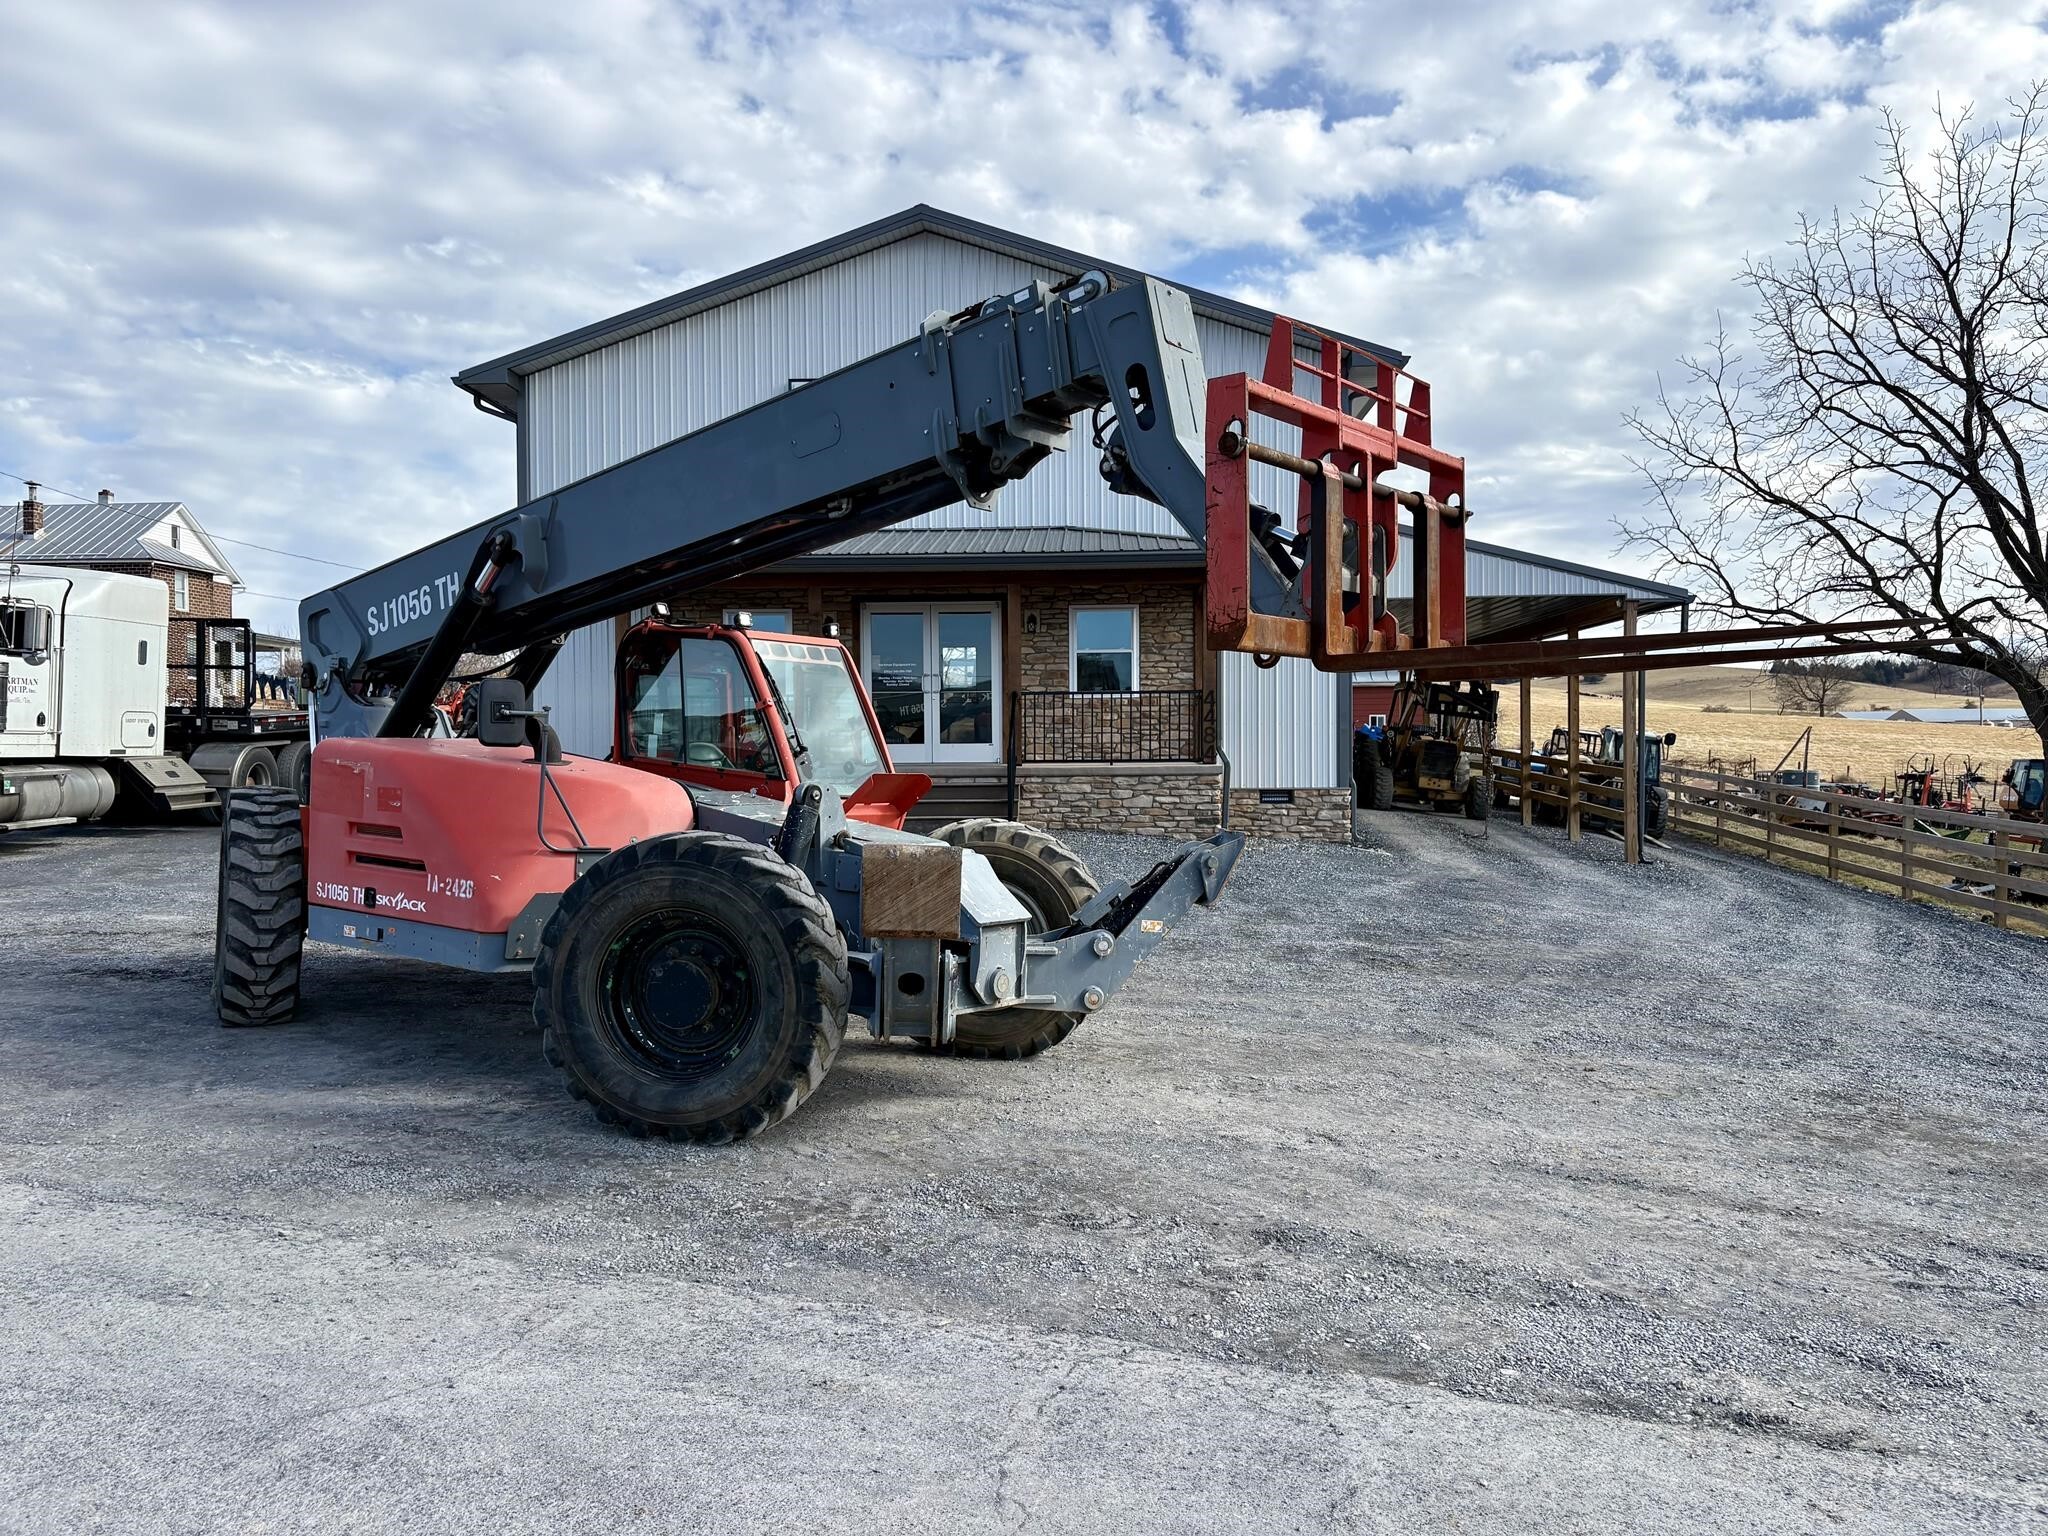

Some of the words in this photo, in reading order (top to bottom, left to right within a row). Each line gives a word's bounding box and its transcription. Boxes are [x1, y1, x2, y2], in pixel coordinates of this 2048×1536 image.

[367, 585, 432, 636] SJ1056
[434, 571, 460, 610] TH
[7, 677, 39, 686] ARTMAN
[7, 685, 28, 694] QUIP.
[316, 881, 349, 903] SJ1056
[352, 887, 365, 905] TH
[376, 891, 427, 913] SKYJACK
